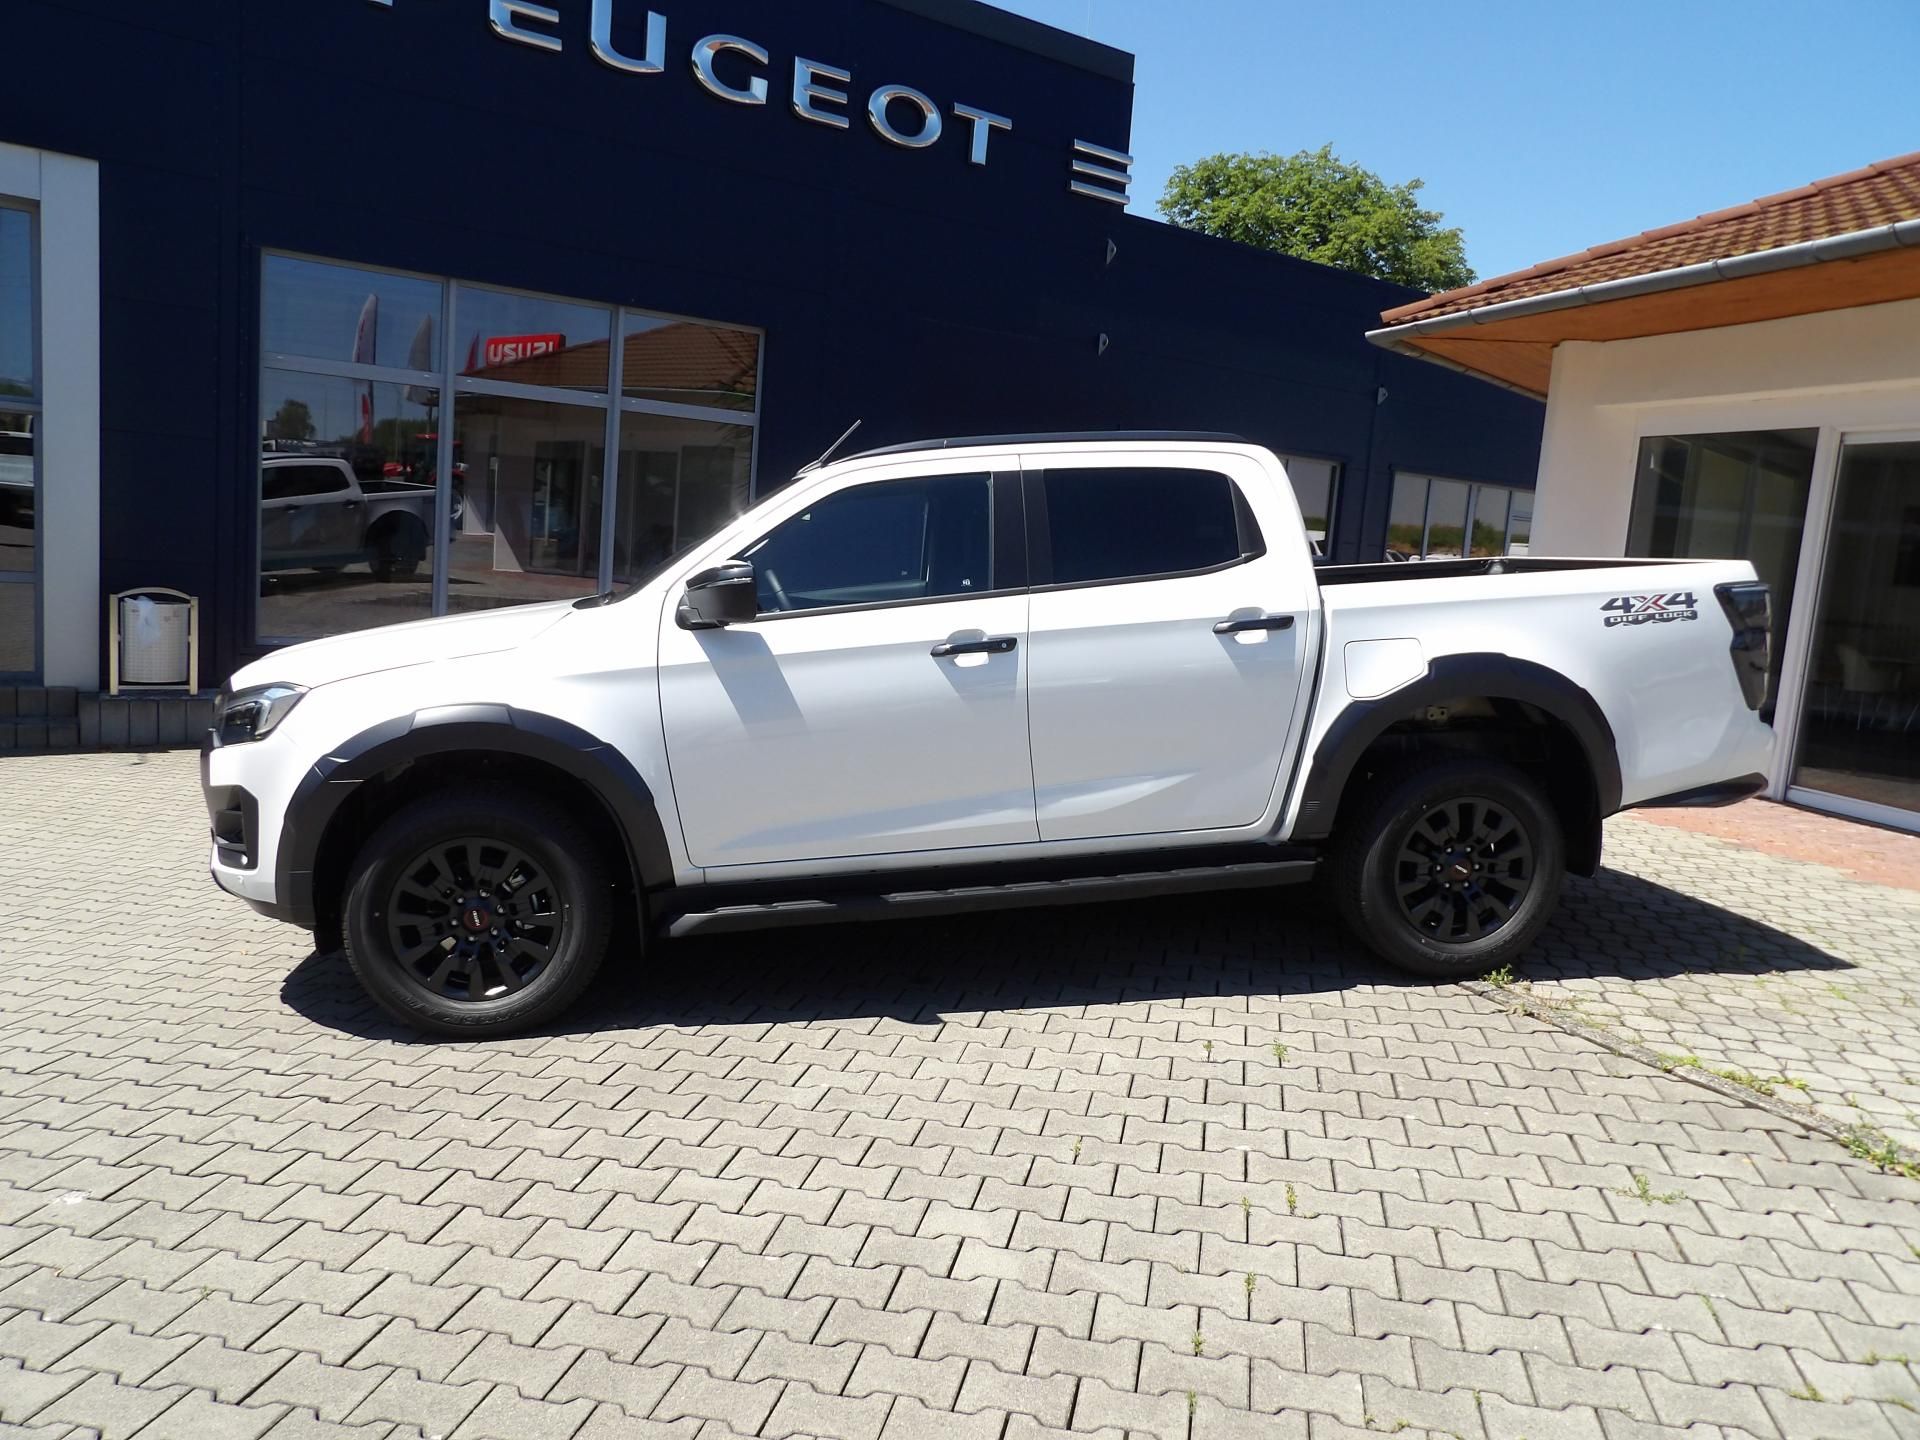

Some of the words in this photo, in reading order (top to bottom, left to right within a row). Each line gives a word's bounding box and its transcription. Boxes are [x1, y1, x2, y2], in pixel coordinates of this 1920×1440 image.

[367, 0, 1013, 166] EUGEOT
[1609, 614, 1648, 623] DIFF
[1654, 610, 1693, 619] LOCK
